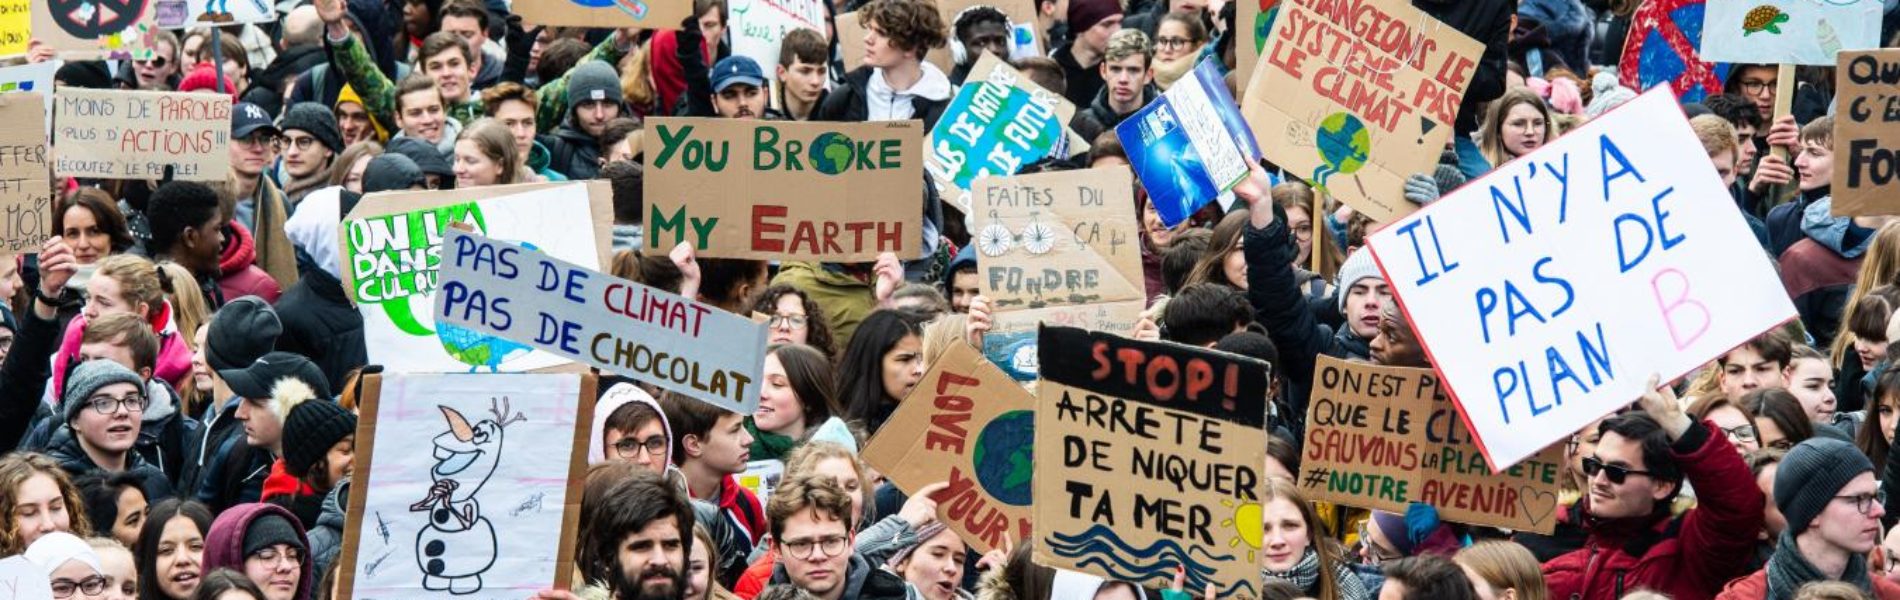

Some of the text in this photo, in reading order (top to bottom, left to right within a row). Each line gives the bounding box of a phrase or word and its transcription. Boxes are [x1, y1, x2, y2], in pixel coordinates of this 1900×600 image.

[1294, 0, 1475, 92] ANGEONS LE
[1848, 54, 1900, 85] QU
[128, 97, 150, 119] DE
[157, 95, 230, 121] PAROLES
[949, 112, 985, 147] DE
[968, 64, 1016, 124] NATURE
[1268, 40, 1307, 80] LE
[1312, 66, 1412, 133] CLIMAT
[1413, 78, 1461, 128] PAS
[1850, 94, 1900, 122] C'E
[64, 127, 96, 140] PLUS
[653, 124, 729, 172] YOU
[125, 163, 141, 174] LE
[987, 142, 1022, 176] DE
[1848, 138, 1900, 188] FO
[1078, 186, 1104, 207] DU
[1396, 134, 1647, 287] IL N'Y A
[350, 214, 410, 255] ON
[651, 203, 903, 259] MY EARTH
[353, 246, 442, 280] DANS
[358, 270, 439, 301] CUL QU
[454, 235, 519, 279] PAS
[535, 261, 590, 304] DE
[988, 266, 1100, 297] FONDRE
[1476, 186, 1686, 344] PAS DE
[443, 281, 752, 403] PAS DE CHOCOLAT
[1493, 268, 1711, 424] PLAN B
[1091, 341, 1240, 411] STOP!
[1321, 366, 1446, 400] ON EST PL
[1056, 390, 1223, 454] ARRETE
[1313, 399, 1472, 445] QUE LE CL
[925, 371, 1009, 549] LOVE YOUR
[1063, 435, 1259, 502] DE NIQUER
[1308, 429, 1418, 471] SAUVONS
[1421, 452, 1438, 470] LA
[1304, 467, 1409, 503] #NOTRE
[1066, 480, 1215, 546] TA MER
